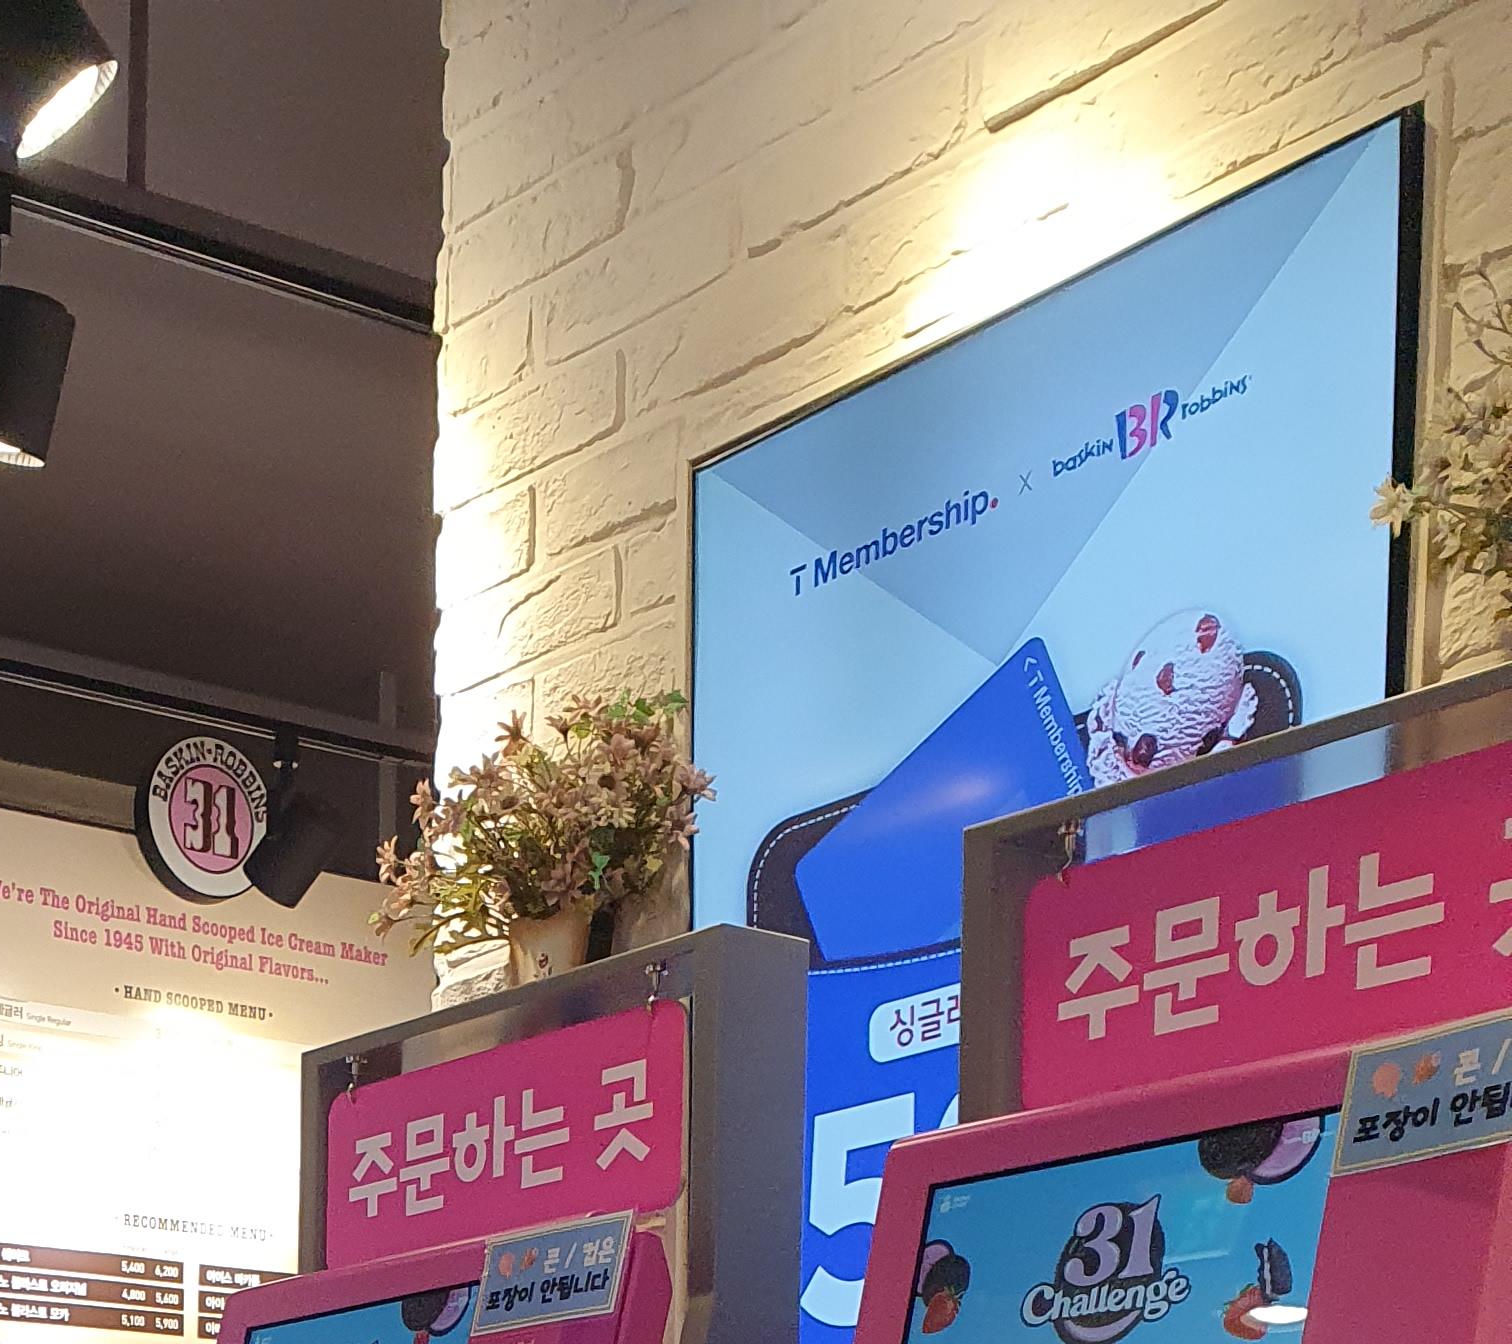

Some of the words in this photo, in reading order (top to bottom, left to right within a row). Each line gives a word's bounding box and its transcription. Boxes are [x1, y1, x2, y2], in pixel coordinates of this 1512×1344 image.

[1052, 434, 1115, 479] baskin
[1181, 374, 1248, 421] robbins
[183, 777, 239, 859] 31
[40, 887, 69, 910] The
[76, 894, 140, 923] Original
[146, 907, 187, 932] Hand
[192, 916, 255, 943] Scooped
[260, 926, 284, 950] Ice
[288, 933, 338, 957] Cream
[340, 942, 388, 967] Maker
[53, 921, 97, 946] Since
[104, 929, 143, 952] 1945
[149, 936, 186, 961] With
[192, 946, 253, 973] Original
[1056, 853, 1445, 1039] 주문하는
[123, 985, 162, 1004] HAND
[165, 992, 224, 1014] SCOOPED
[228, 1000, 267, 1021] MENU
[349, 1088, 569, 1218] 주문하는
[594, 1059, 653, 1170] 곳
[1353, 1097, 1440, 1143] 포장이
[1450, 1082, 1512, 1127] 안됩
[1063, 1194, 1163, 1288] 31
[486, 1282, 535, 1311] 포장이
[540, 1268, 609, 1304] 안됩니다
[1021, 1266, 1191, 1330] Challenge
